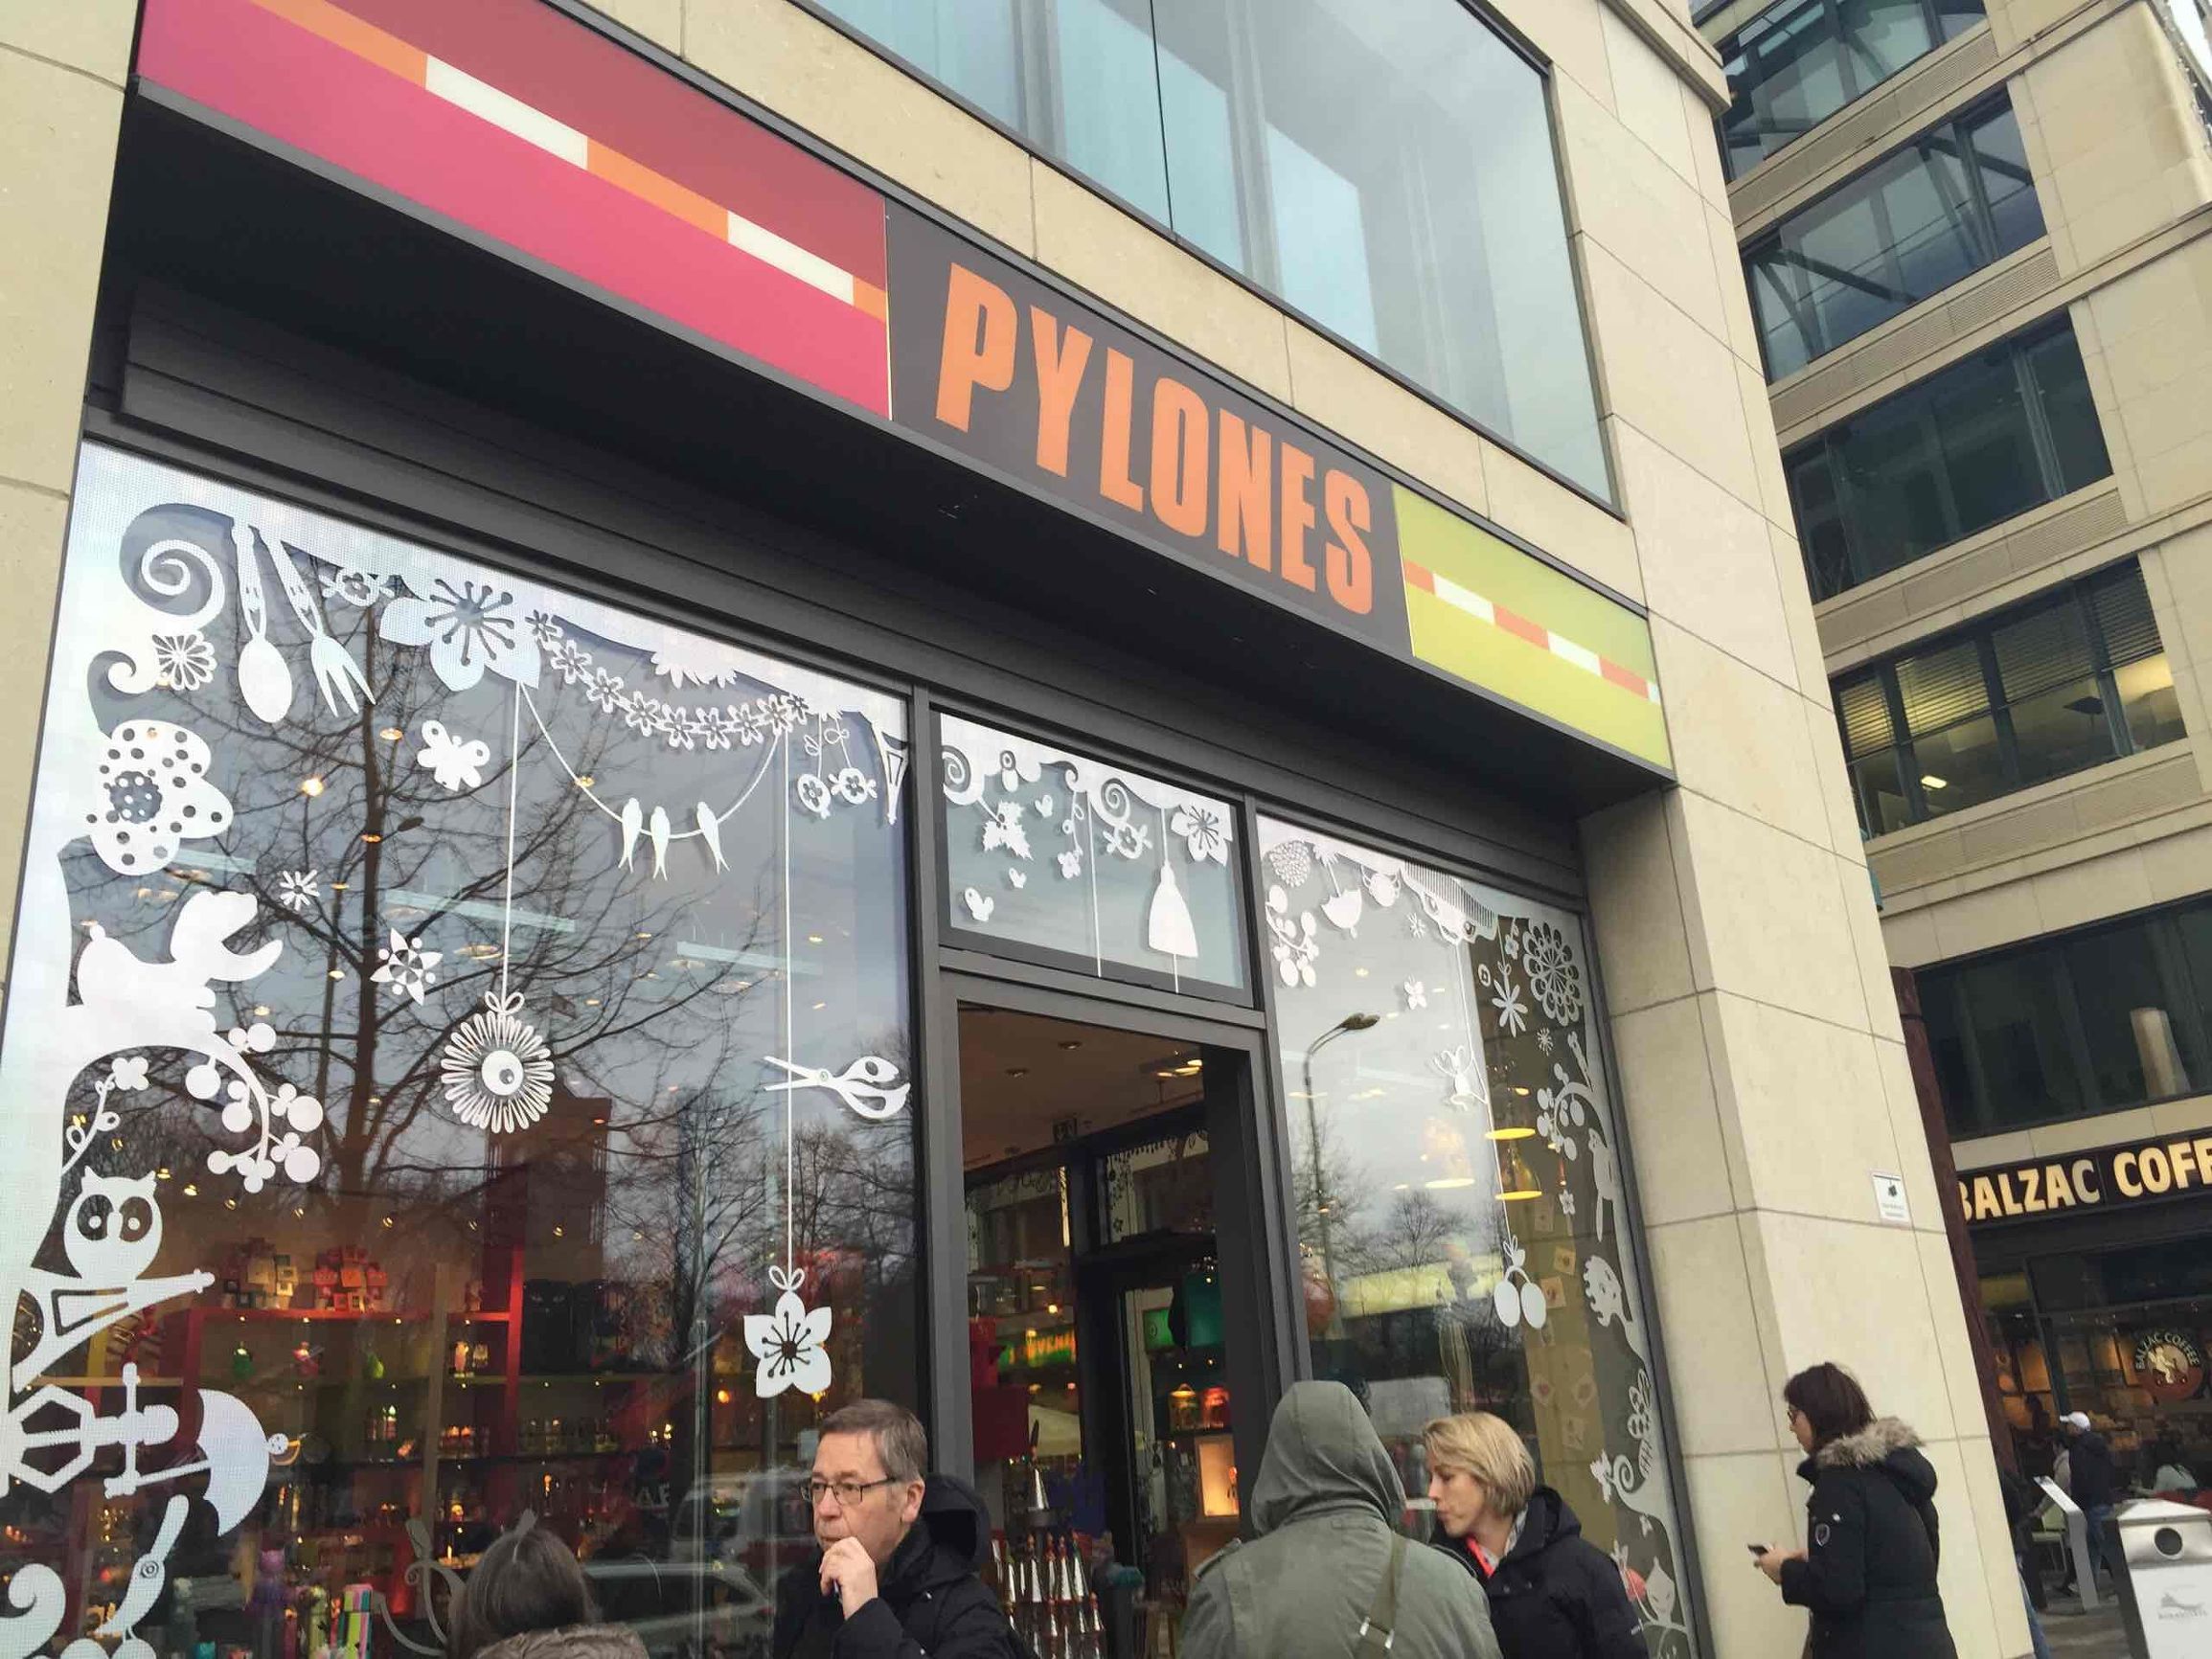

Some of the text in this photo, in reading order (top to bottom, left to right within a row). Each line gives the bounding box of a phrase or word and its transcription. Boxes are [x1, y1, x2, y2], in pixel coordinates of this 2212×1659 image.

[935, 261, 1374, 616] PYLONES
[2113, 1137, 2212, 1197] COFF
[2135, 1332, 2201, 1370] BALZAC COFFEE
